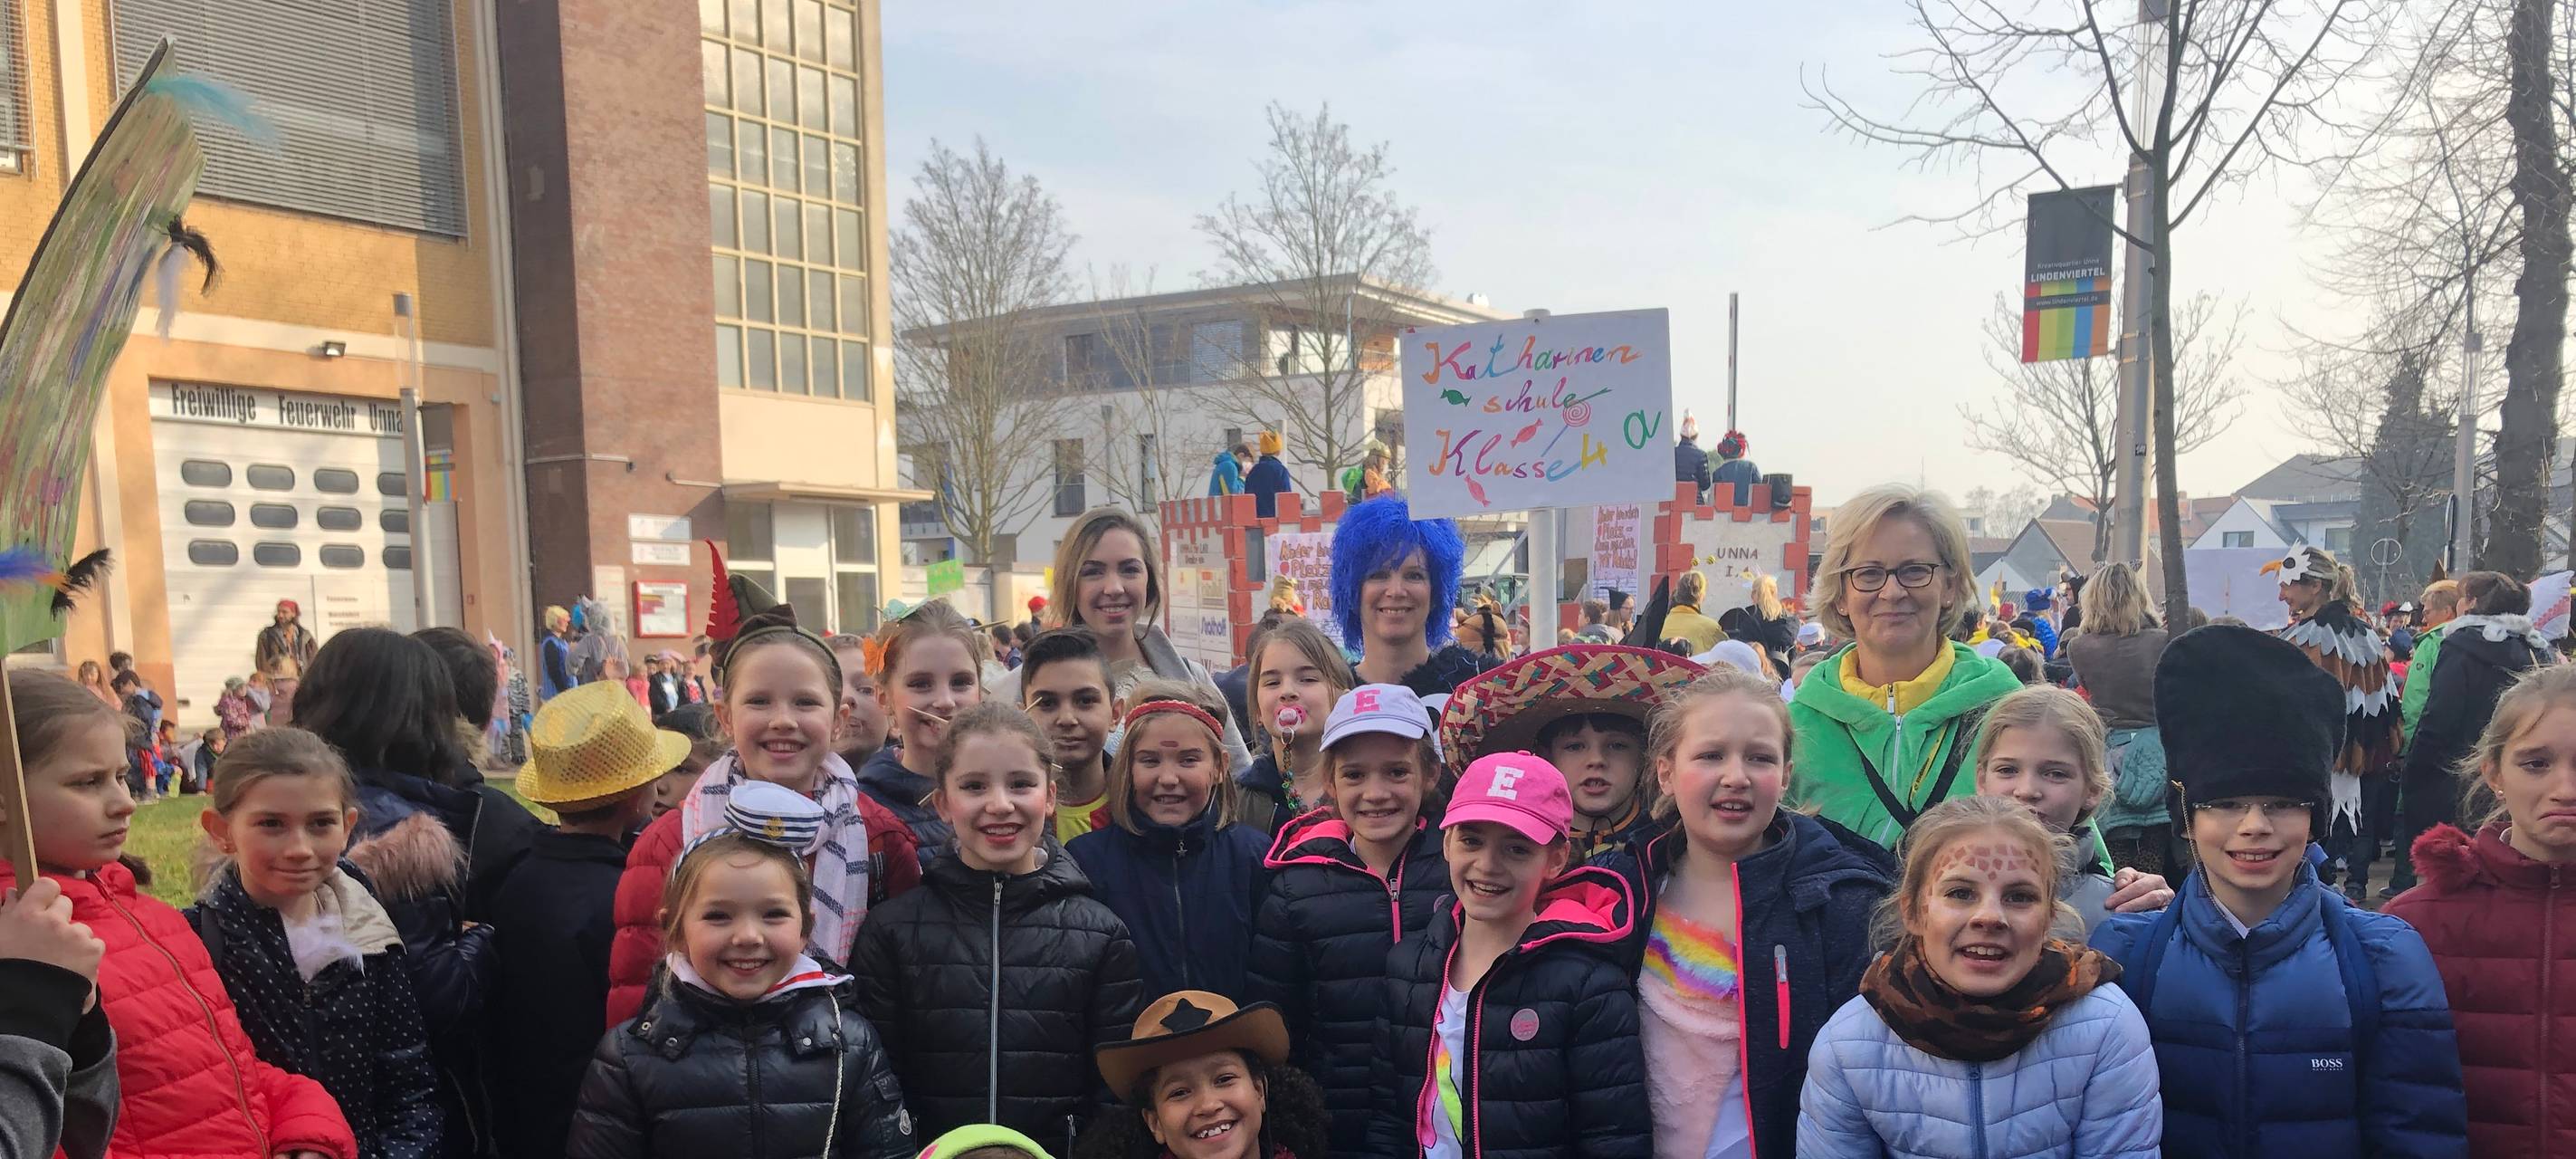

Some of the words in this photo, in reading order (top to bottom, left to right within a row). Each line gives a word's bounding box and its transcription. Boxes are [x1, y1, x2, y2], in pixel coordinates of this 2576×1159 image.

[2030, 266, 2105, 283] LINDENVIERTEL
[2036, 295, 2098, 306] www.lindenviertel.de
[1422, 333, 1644, 384] Katharinen
[171, 383, 257, 424] Freiwillige
[277, 391, 357, 430] Feuerwehr
[367, 402, 404, 434] Unna
[1482, 377, 1612, 413] schule
[1428, 430, 1581, 482] Klasse
[1717, 547, 1759, 560] UNNA
[1353, 688, 1381, 714] E
[1485, 765, 1525, 800] E
[2311, 1058, 2343, 1068] BOSS
